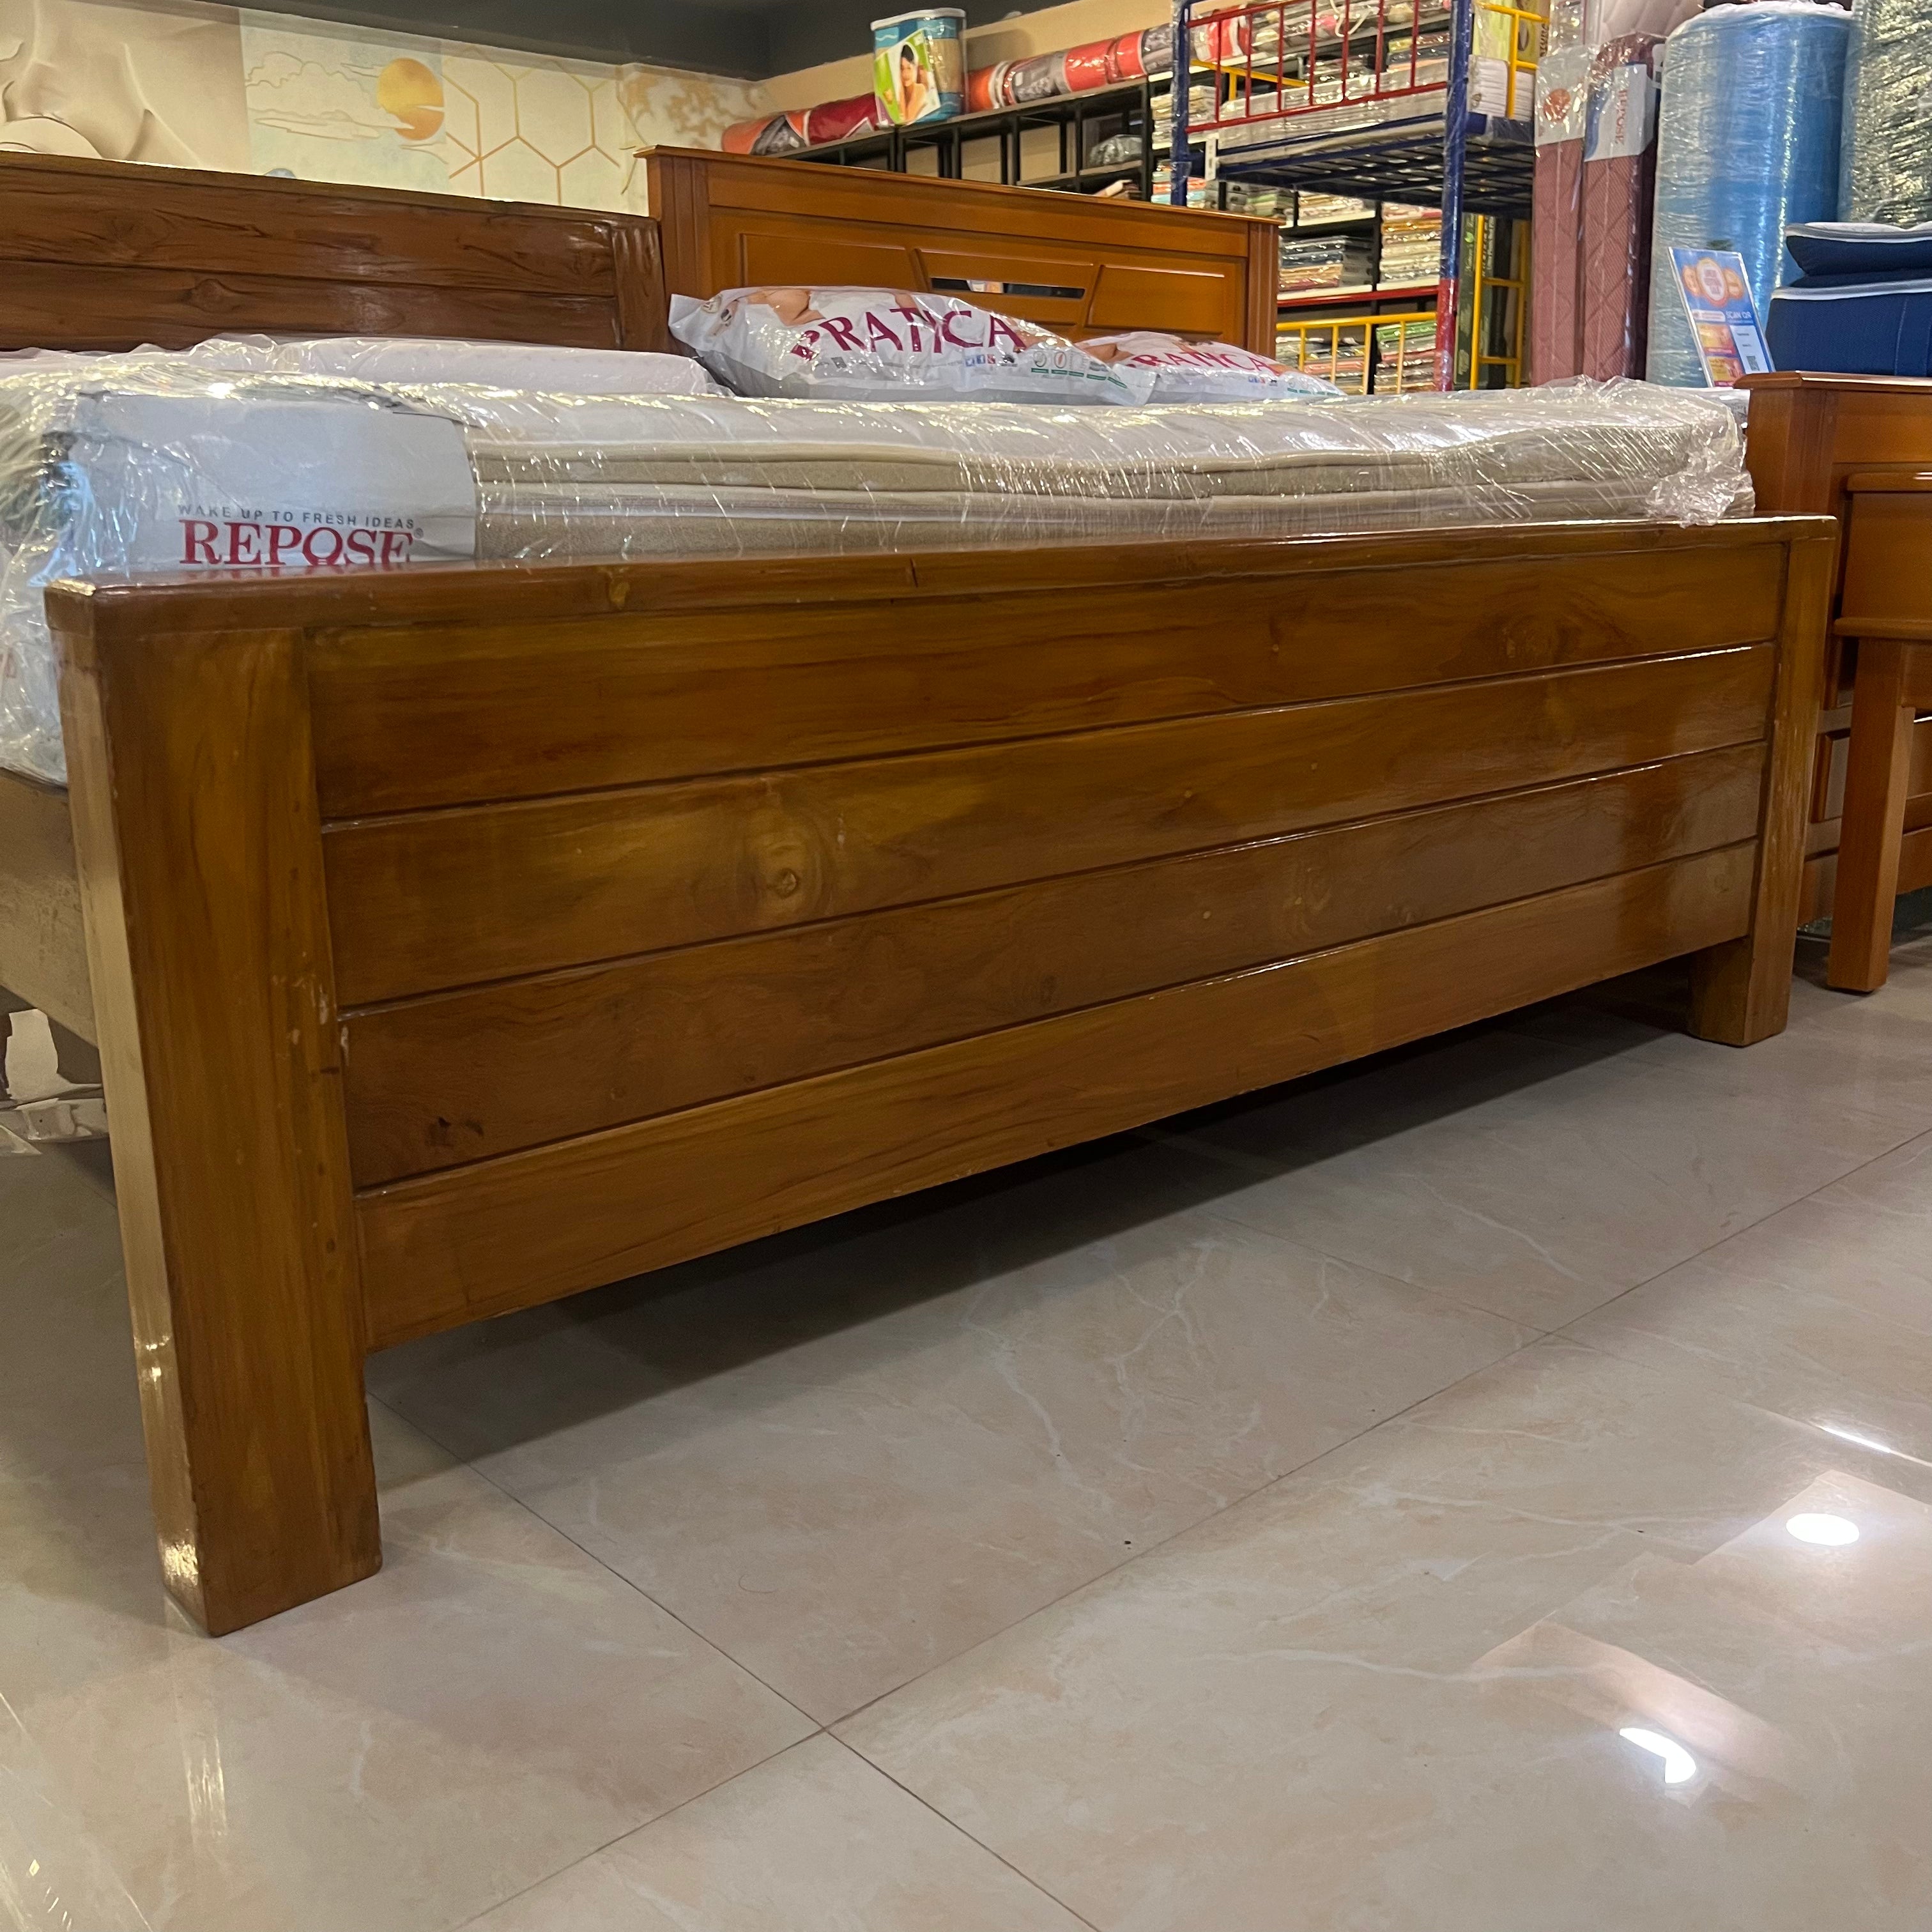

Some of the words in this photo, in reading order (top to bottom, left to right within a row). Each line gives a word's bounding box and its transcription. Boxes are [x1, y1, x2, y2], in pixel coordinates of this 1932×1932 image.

[791, 307, 1028, 361] PRATICA
[1126, 352, 1281, 376] RATICA
[178, 504, 231, 518] WAKE
[241, 509, 263, 520] UP
[272, 511, 293, 522] TO
[303, 512, 356, 526] FRESH
[365, 516, 414, 529] IDEAS
[179, 519, 413, 566] REPOSE
